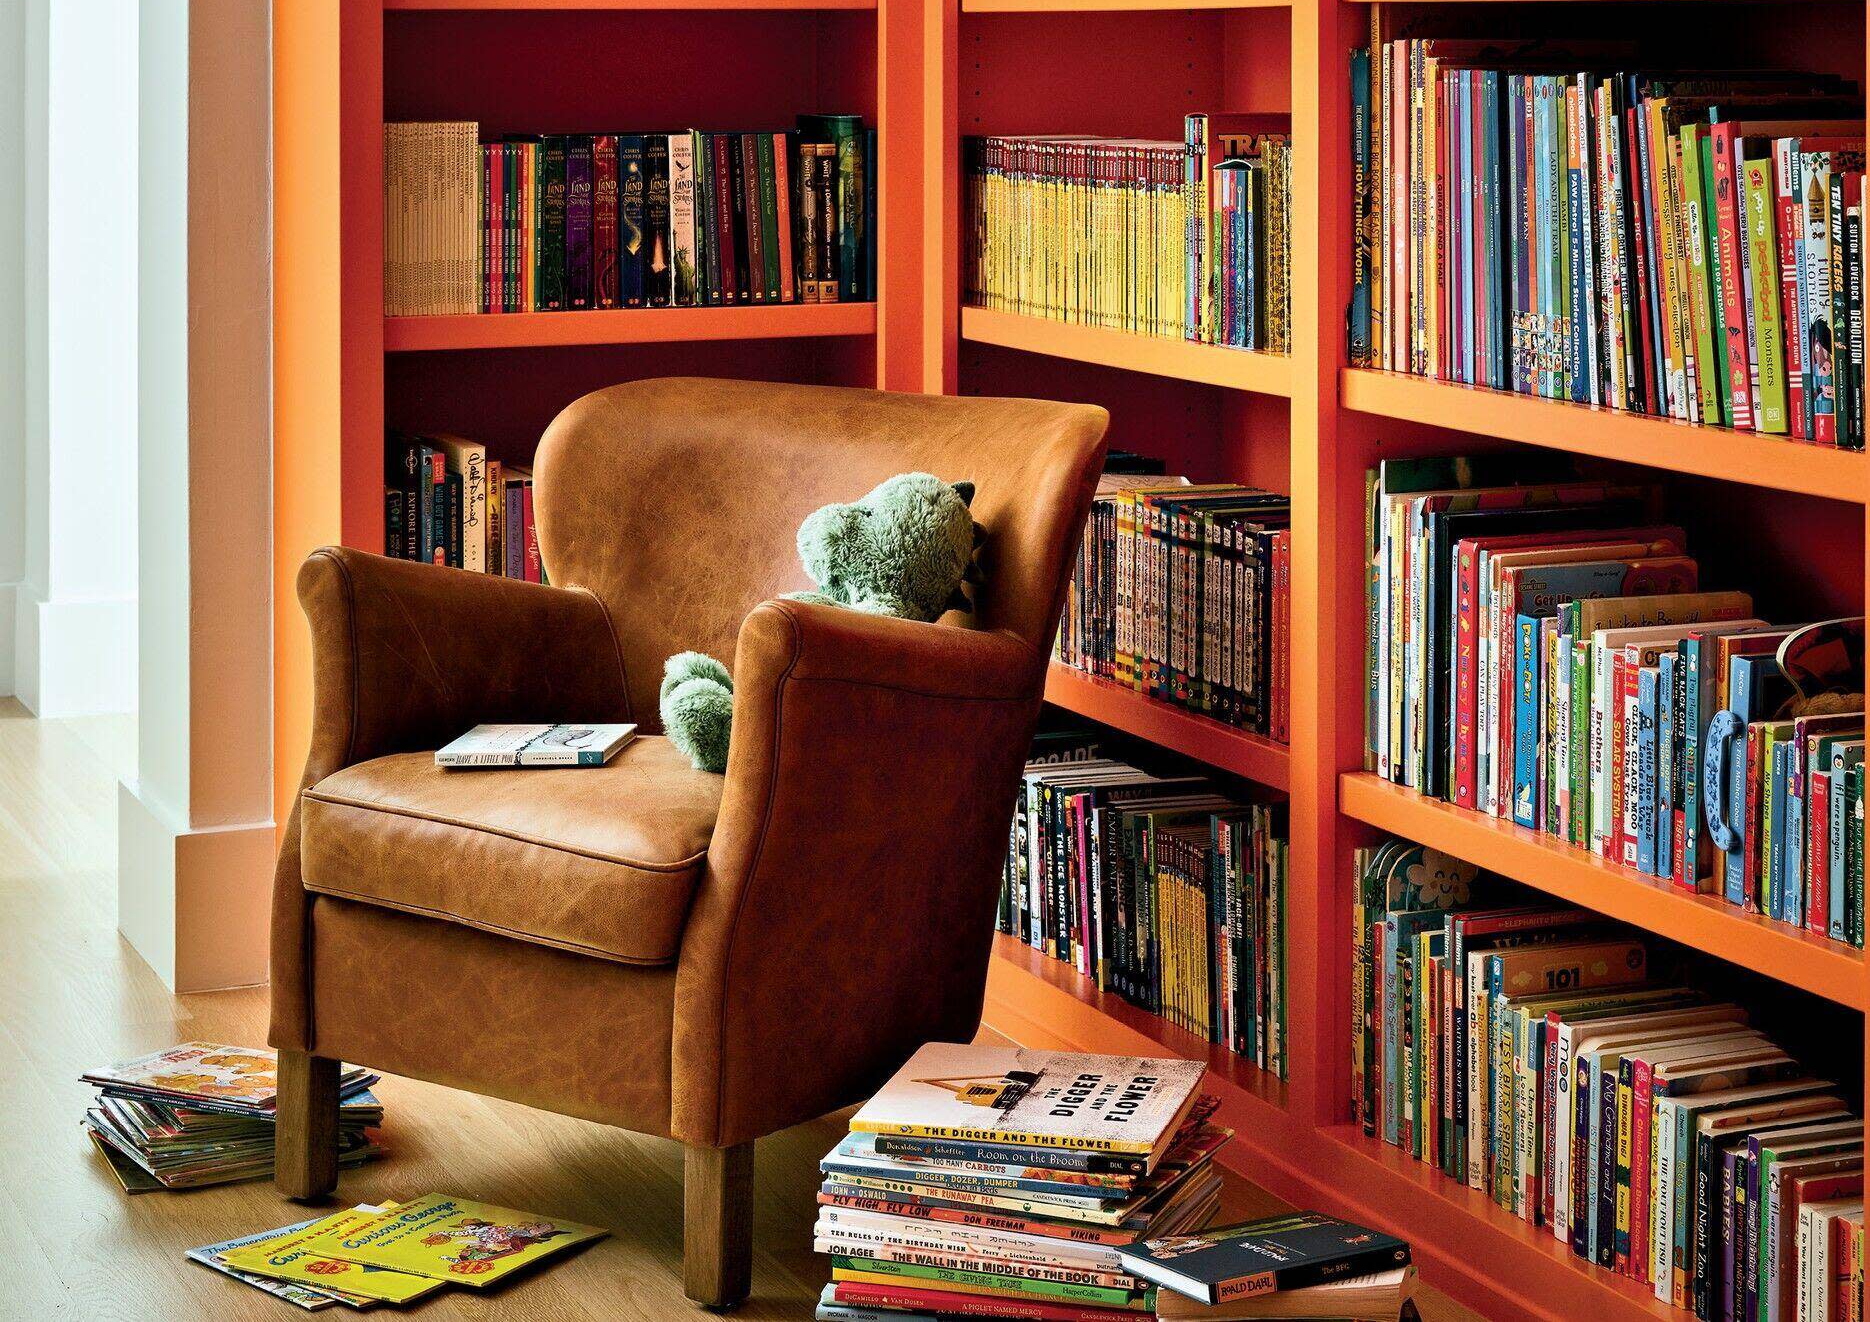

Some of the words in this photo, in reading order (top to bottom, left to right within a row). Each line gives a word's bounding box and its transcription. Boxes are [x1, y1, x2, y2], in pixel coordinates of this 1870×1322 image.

[1355, 164, 1363, 194] HOW
[1831, 185, 1842, 210] TEN
[1355, 197, 1363, 243] THINGS
[1832, 213, 1843, 241] TINY
[1849, 224, 1858, 254] SUTTON
[1355, 247, 1364, 284] WORK
[1721, 227, 1735, 307] Animals
[1833, 244, 1844, 292] RACERS
[1850, 262, 1860, 300] LOVELOCK
[1850, 310, 1861, 364] DEMOLITION
[1764, 328, 1775, 386] Monsters
[436, 486, 444, 502] WHO
[436, 520, 445, 545] GAME?
[1678, 681, 1686, 710] BLACK
[1678, 714, 1686, 737] CATS
[1595, 710, 1603, 773] Brothers
[1612, 720, 1621, 762] SOLAR
[1612, 766, 1621, 818] SYSTEM
[1057, 832, 1065, 857] THE
[1058, 885, 1066, 938] MONSTER
[1456, 1057, 1462, 1068] IS
[1559, 1039, 1570, 1092] moo
[1044, 1088, 1061, 1099] THE
[1049, 1074, 1103, 1117] DIGGER
[1101, 1084, 1118, 1096] THE
[1104, 1077, 1158, 1122] FLOWER
[1604, 1080, 1613, 1102] My
[1090, 1097, 1106, 1110] AND
[1620, 1094, 1628, 1136] DINOSAUR
[886, 1142, 922, 1152] Donaldson
[924, 1127, 946, 1135] THE
[952, 1130, 996, 1140] DIGGER
[1003, 1133, 1026, 1142] AND
[1034, 1135, 1056, 1144] THE
[1062, 1138, 1111, 1149] FLOWER
[1604, 1106, 1614, 1165] Grandma
[966, 1162, 1006, 1173] CARROTS
[977, 1150, 1008, 1160] Room
[1013, 1153, 1026, 1161] on
[1031, 1150, 1046, 1163] the
[1050, 1155, 1084, 1167] Broom
[1110, 1161, 1123, 1169] DIAL
[1660, 1156, 1668, 1177] THE
[984, 1179, 1018, 1188] DUMPER
[1604, 1167, 1612, 1190] and
[1698, 1171, 1707, 1206] Good
[830, 1186, 848, 1195] JOHN
[859, 1189, 886, 1199] OSWALD
[942, 1190, 976, 1202] RUNAWAY
[981, 1196, 995, 1205] PEA
[1634, 1189, 1642, 1218] Boom
[886, 1204, 903, 1213] FLY
[910, 1207, 931, 1216] LOW
[1659, 1180, 1667, 1238] POUT-POUT
[964, 1215, 981, 1224] DON
[986, 1218, 1025, 1230] FREEMAN
[1697, 1210, 1707, 1249] Night
[849, 1232, 872, 1240] RULES
[906, 1239, 943, 1249] BIRTHDAY
[947, 1244, 966, 1252] WISH
[1071, 1231, 1100, 1241] VIKING
[827, 1245, 847, 1254] JON
[850, 1248, 874, 1257] AGEE
[1659, 1241, 1667, 1266] FISH
[892, 1253, 918, 1262] THE
[920, 1255, 945, 1266] WALL
[947, 1259, 957, 1268] IN
[960, 1261, 979, 1271] THE
[982, 1263, 1024, 1276] MIDDLE
[1028, 1268, 1043, 1278] OF
[1046, 1270, 1064, 1280] THE
[1066, 1272, 1098, 1284] BOOK
[1697, 1253, 1706, 1278] Zoo
[1062, 1287, 1102, 1298] HarperCollins
[1221, 1285, 1246, 1297] ROALD
[1247, 1279, 1272, 1291] DAHL
[969, 1304, 990, 1313] PIGLET
